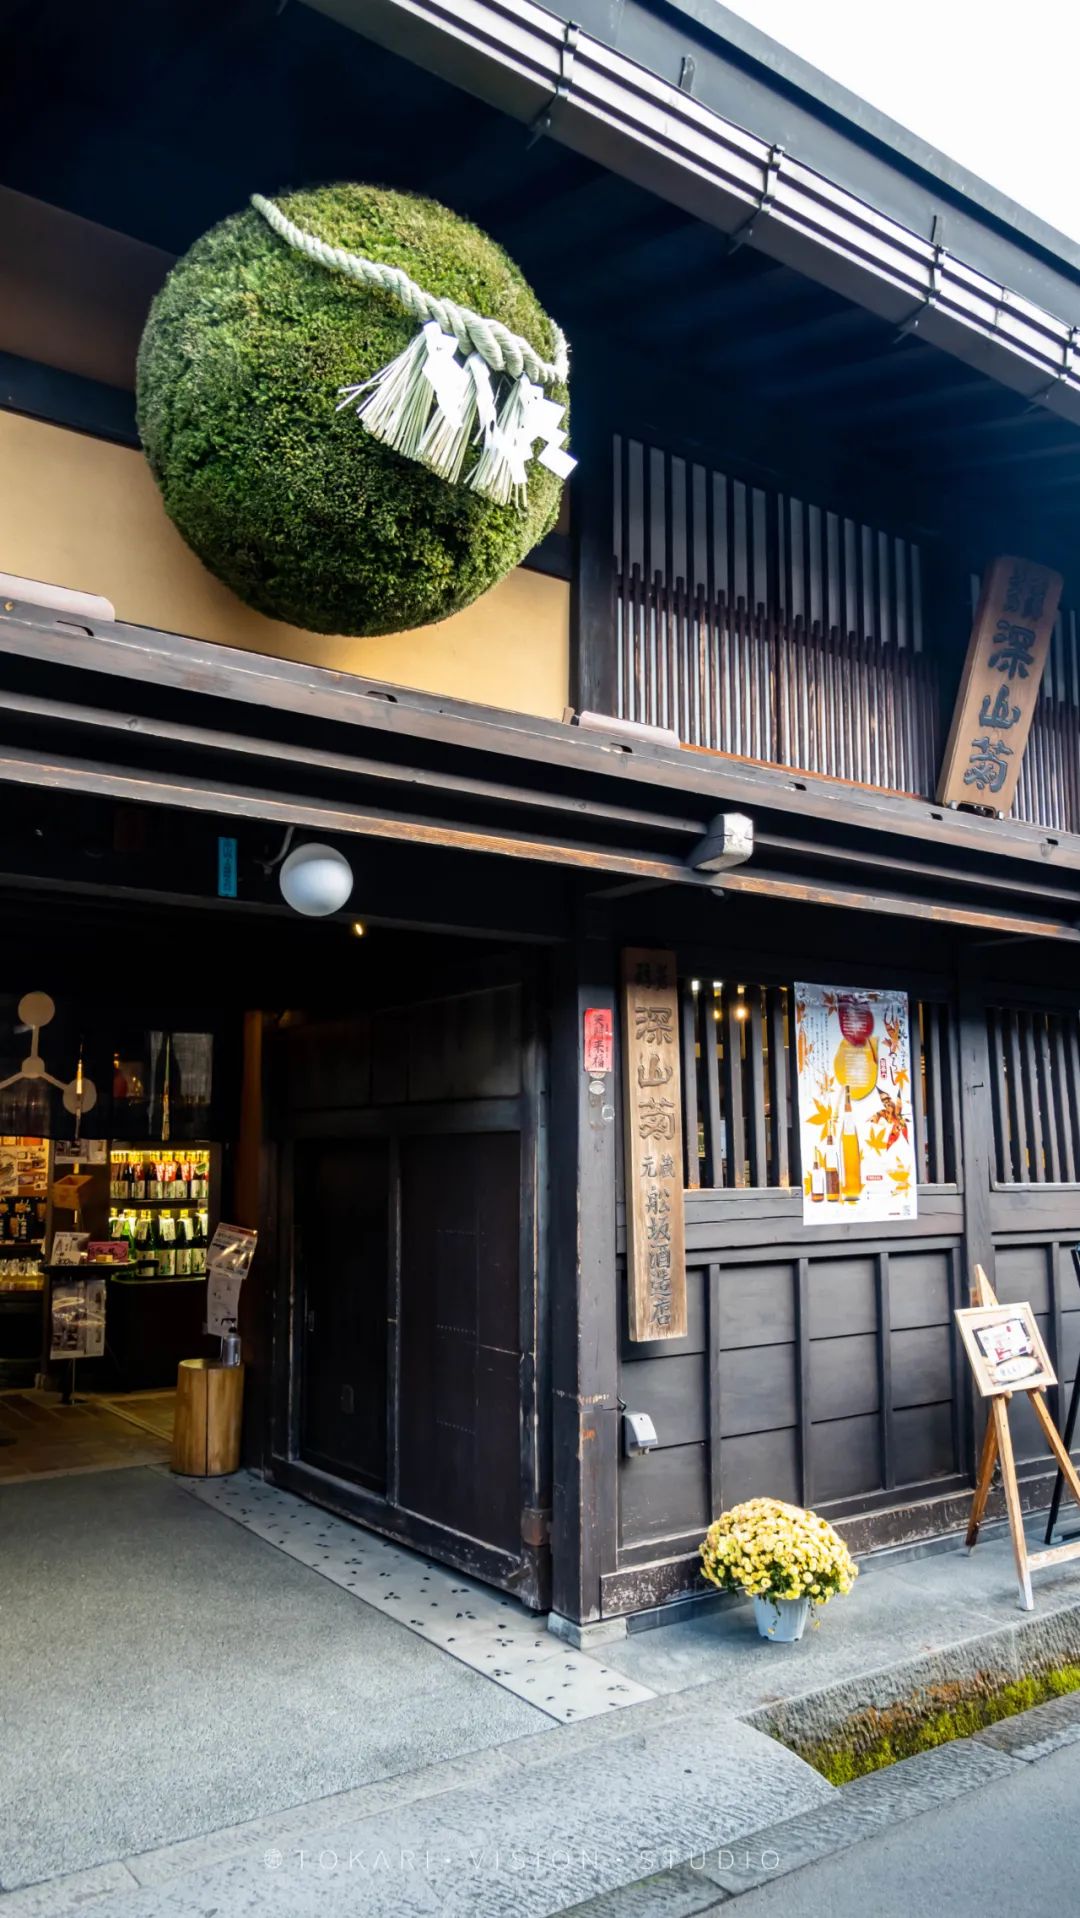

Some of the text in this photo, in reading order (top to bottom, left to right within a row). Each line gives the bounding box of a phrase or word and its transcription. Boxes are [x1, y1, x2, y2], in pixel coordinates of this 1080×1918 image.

[963, 620, 1036, 793] 深山菊
[635, 1006, 676, 1140] 深山菊
